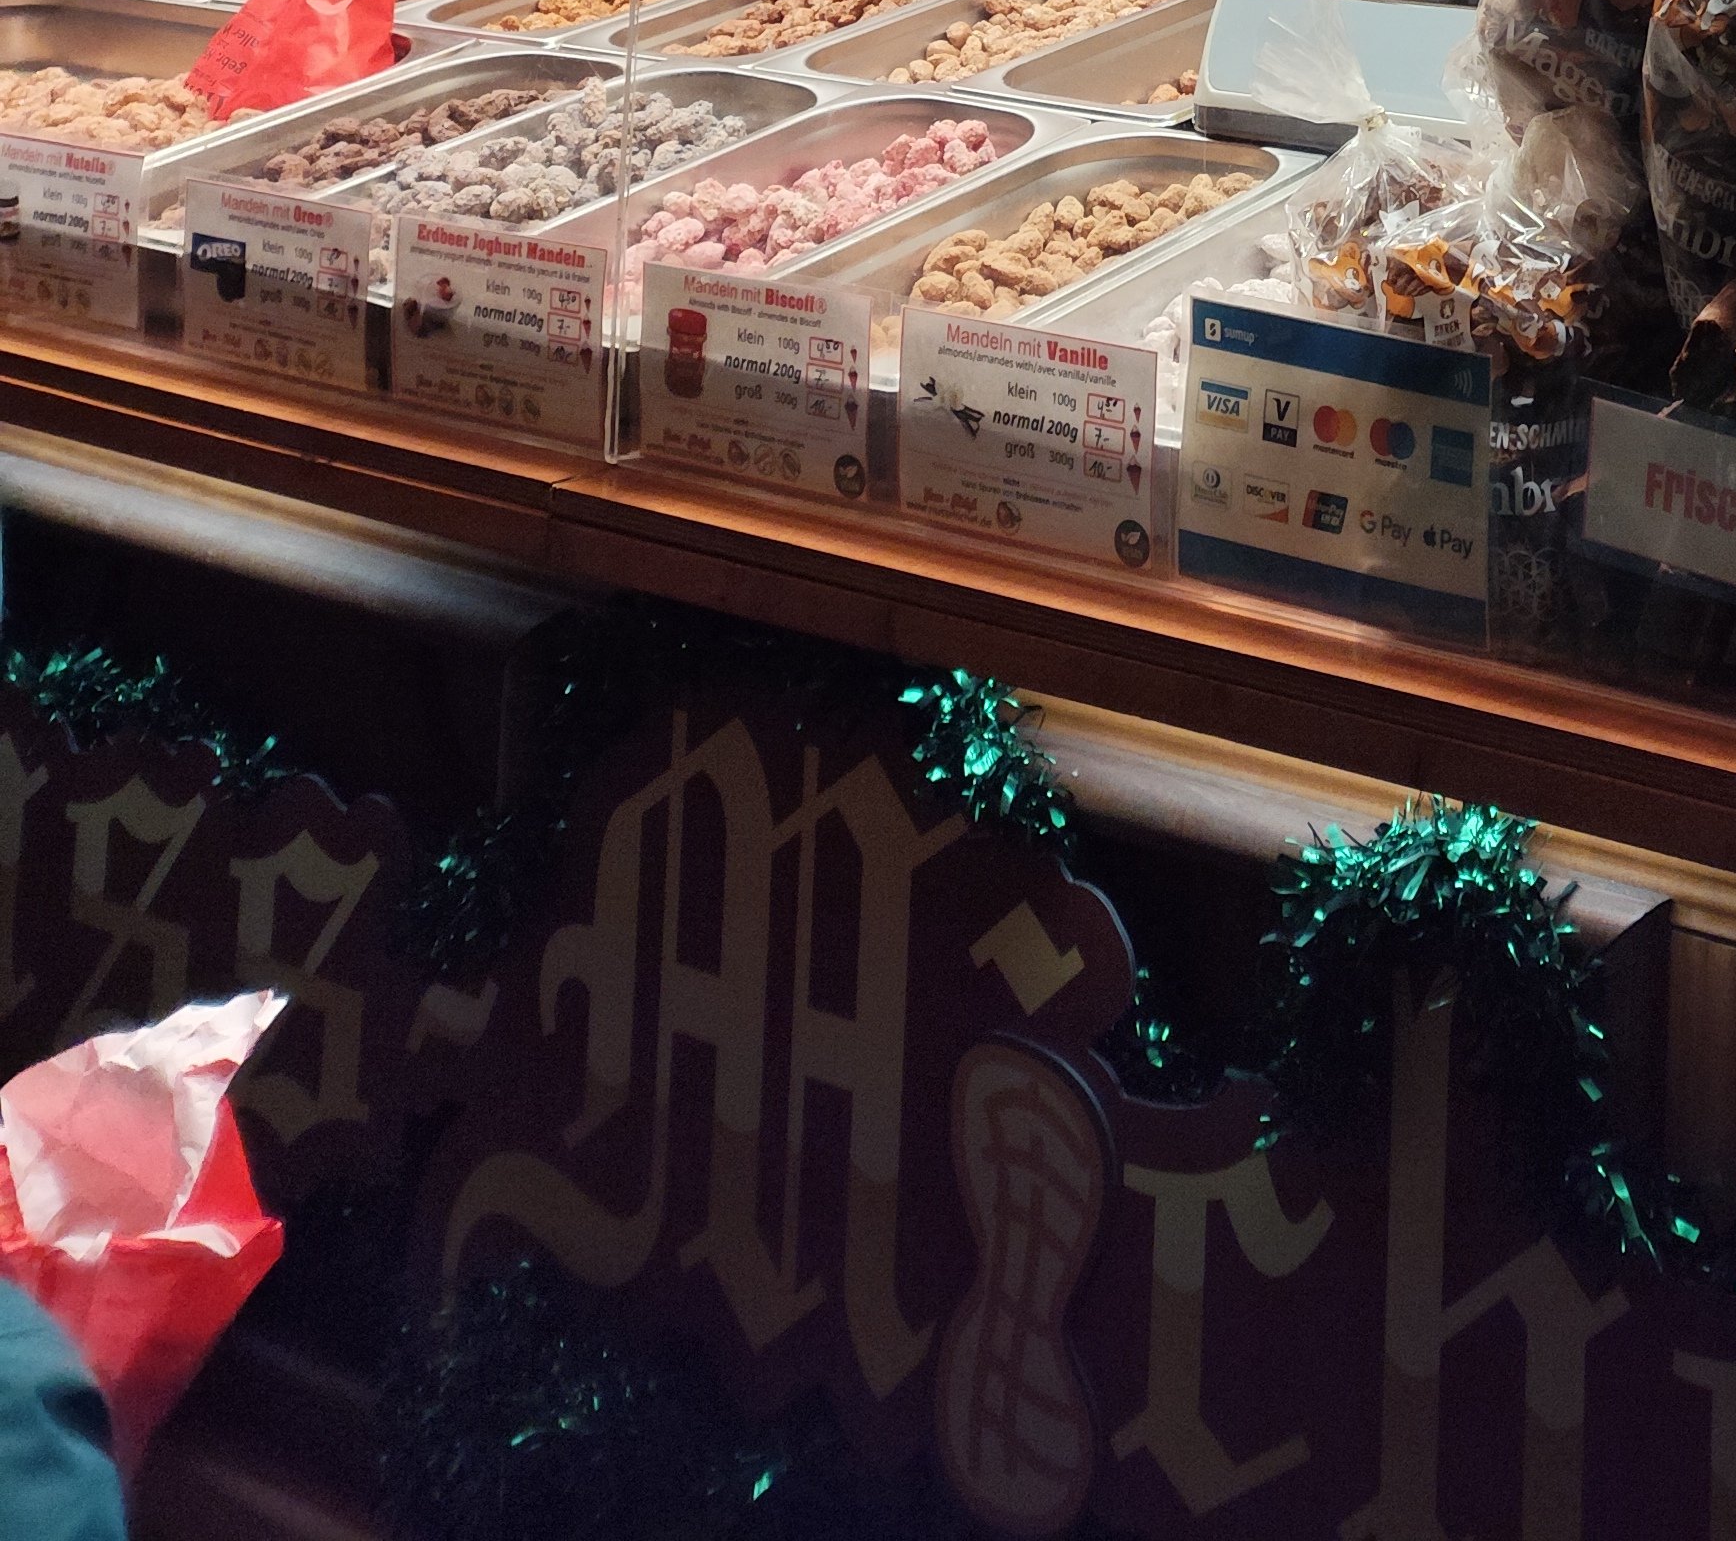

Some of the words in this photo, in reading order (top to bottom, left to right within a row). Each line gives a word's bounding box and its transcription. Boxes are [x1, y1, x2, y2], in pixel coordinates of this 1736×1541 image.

[1, 143, 43, 163] Mandeln
[222, 192, 269, 215] Mandeln
[272, 204, 290, 220] mit
[33, 210, 67, 225] normal
[69, 215, 89, 232] 200g
[197, 242, 242, 261] OREO
[262, 239, 284, 254] klein
[417, 223, 469, 248] Erdbeer
[473, 233, 522, 257] Joghurt
[527, 241, 585, 268] Mandeln
[251, 263, 289, 281] normal
[290, 270, 313, 289] 200g
[486, 279, 510, 296] klein
[522, 287, 543, 303] 100g
[684, 275, 738, 300] Mandeln
[741, 286, 762, 304] mit
[474, 304, 517, 323] normal
[518, 311, 544, 332] 200g
[738, 328, 764, 345] klein
[778, 337, 800, 354] 100g
[946, 323, 1012, 354] Mandeln
[1018, 337, 1041, 359] mit
[1047, 340, 1109, 370] Vanille
[724, 355, 771, 375] normal
[773, 361, 802, 384] 200g
[735, 384, 762, 400] groß
[775, 392, 798, 410] 300g
[1007, 382, 1037, 401] klein
[1052, 392, 1077, 411] 100g
[1207, 395, 1240, 417] VISA
[993, 409, 1045, 433] normal
[1047, 420, 1079, 443] 200g
[1270, 427, 1290, 442] PAY
[1005, 441, 1035, 459] groß
[1049, 450, 1075, 470] 300g
[1313, 444, 1354, 459] mastercard
[1381, 516, 1412, 547] Pay
[1440, 529, 1474, 559] Pay
